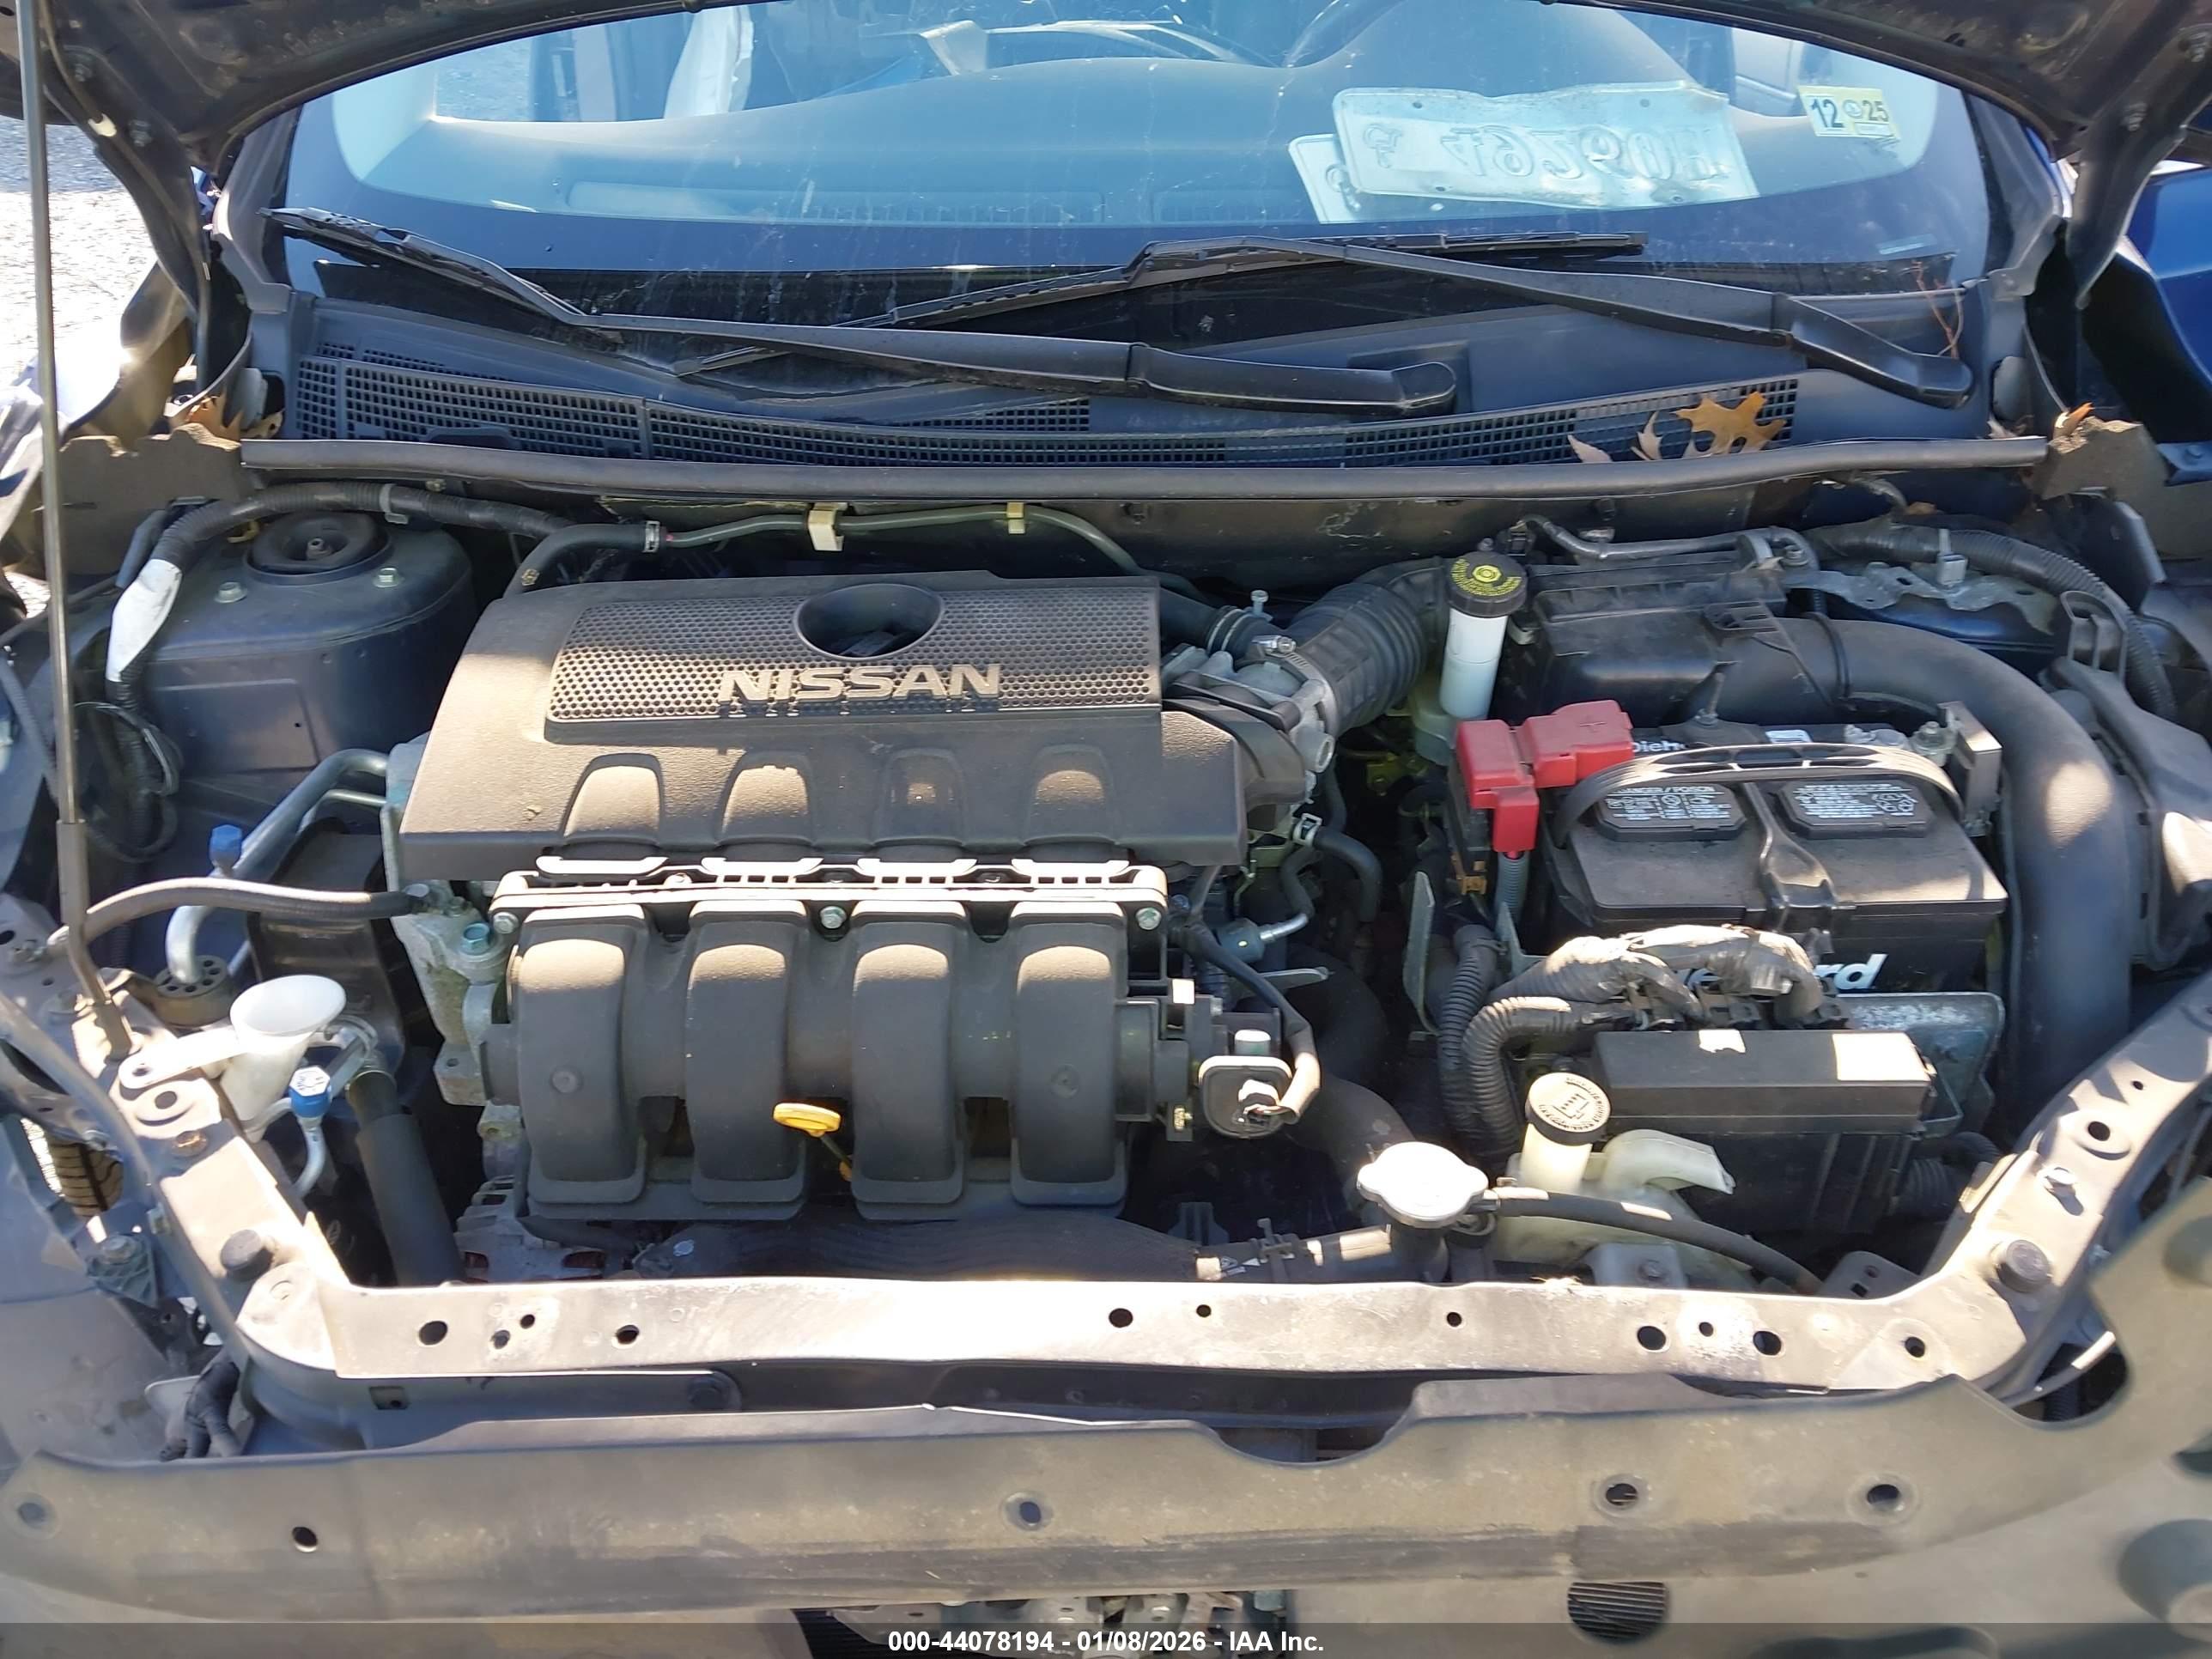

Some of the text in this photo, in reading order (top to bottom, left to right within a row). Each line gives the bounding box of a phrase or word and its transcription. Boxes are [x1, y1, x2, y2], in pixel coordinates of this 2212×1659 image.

[1811, 98, 1890, 128] 12 25
[718, 663, 1000, 702] NISSAN
